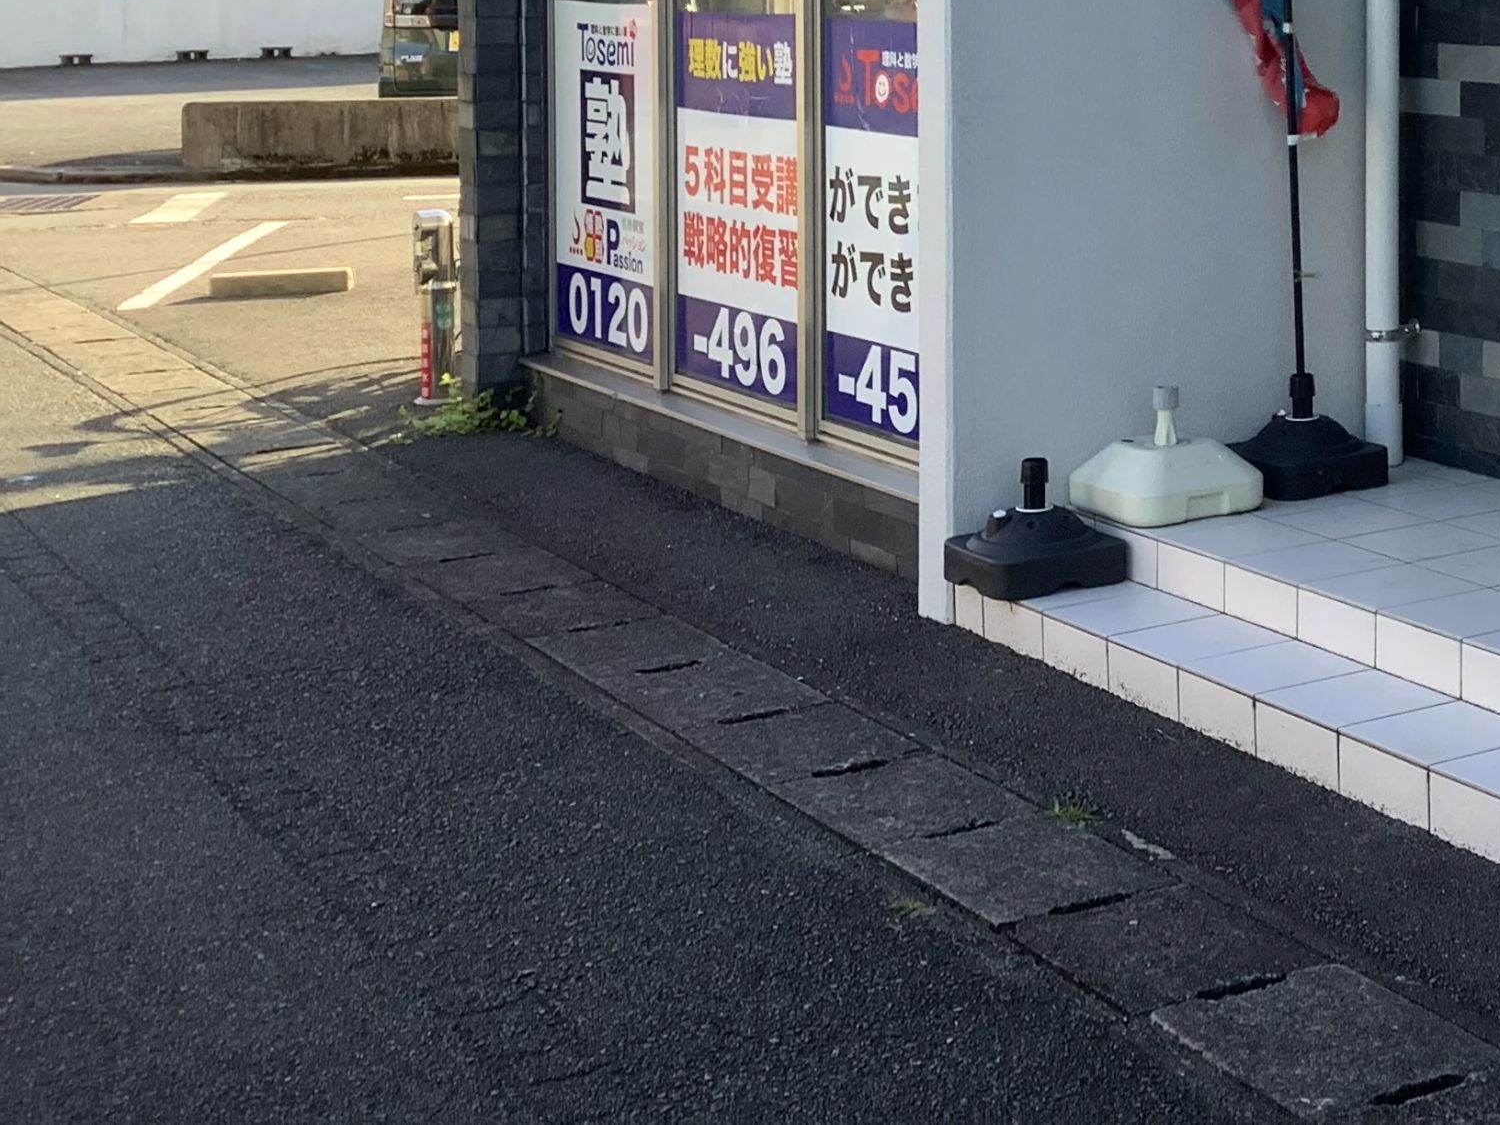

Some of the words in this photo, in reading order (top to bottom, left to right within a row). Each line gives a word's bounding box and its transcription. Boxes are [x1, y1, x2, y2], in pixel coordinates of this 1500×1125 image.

[688, 38, 793, 85] 理数に強い塾
[684, 145, 797, 216] 5科目受講
[606, 218, 644, 275] Passion
[683, 210, 797, 290] 戦略的復習
[568, 272, 649, 354] 0120
